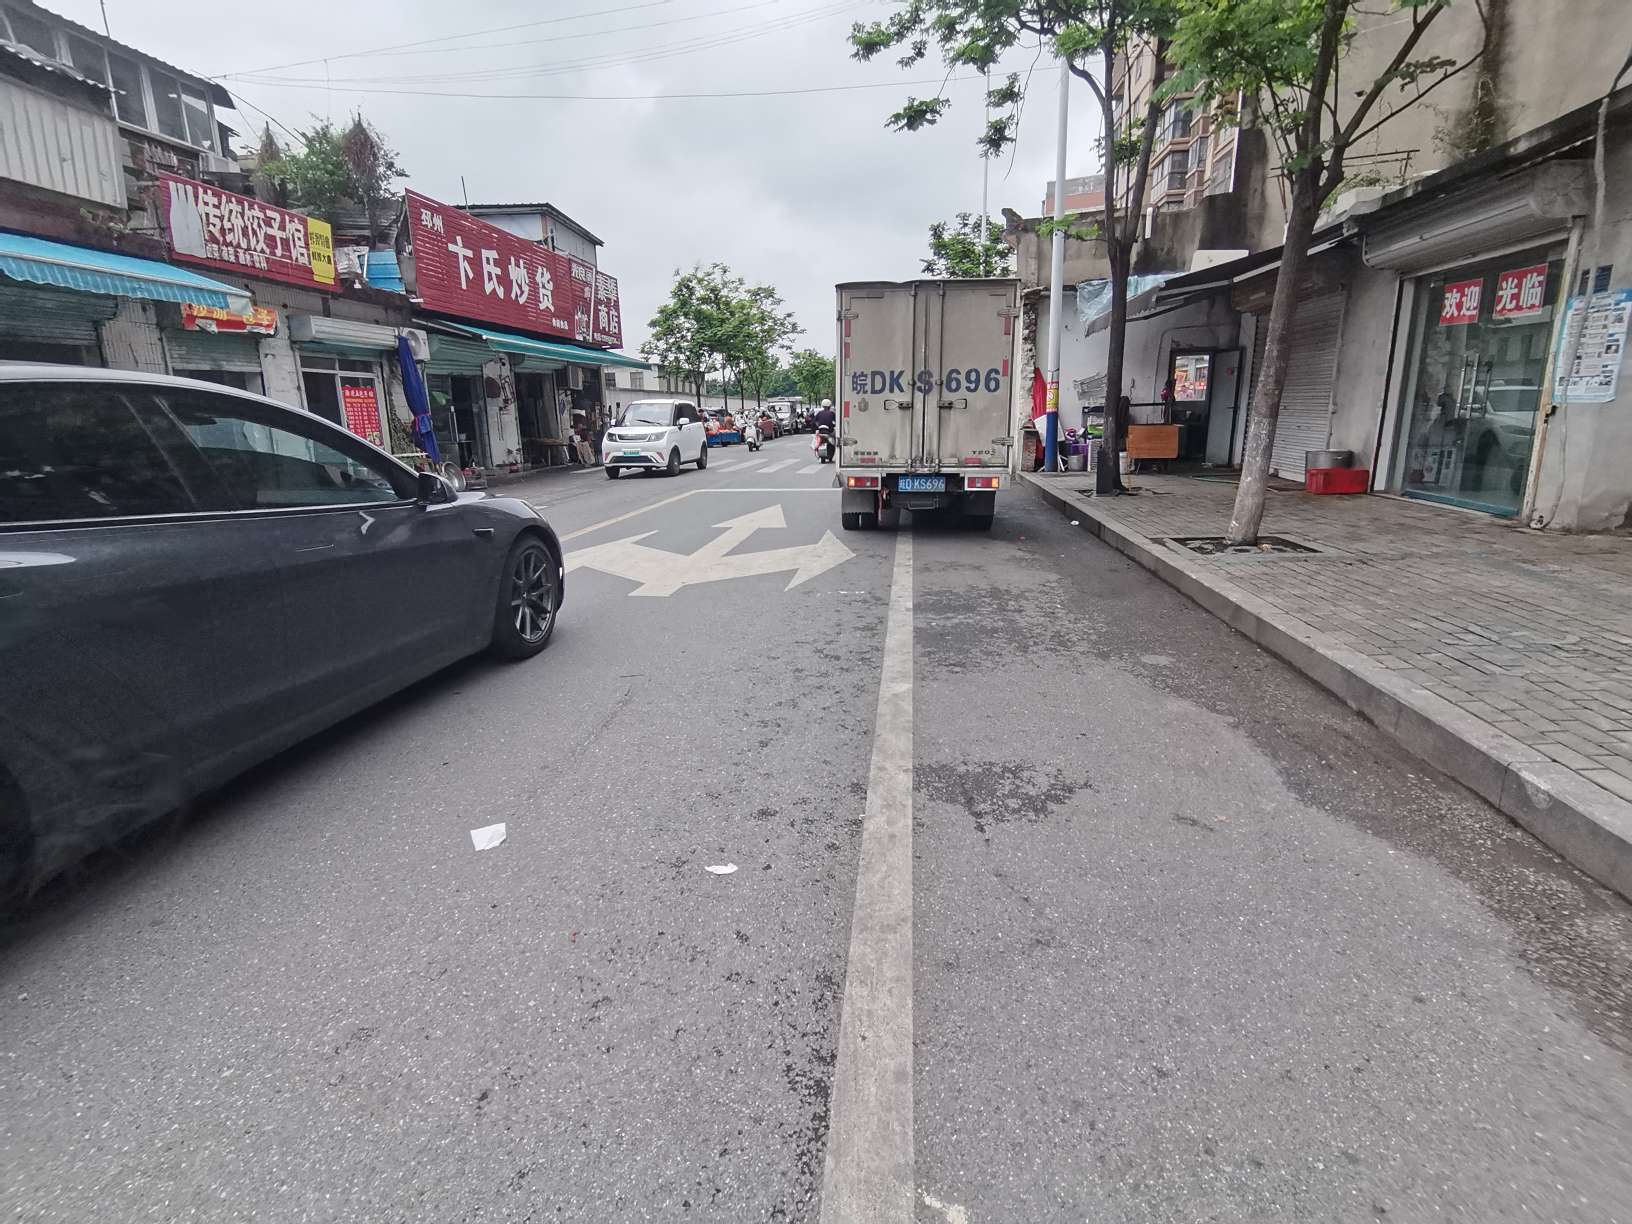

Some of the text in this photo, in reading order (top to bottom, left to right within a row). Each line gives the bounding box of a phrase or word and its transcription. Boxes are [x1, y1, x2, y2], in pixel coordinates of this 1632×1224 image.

[198, 186, 309, 265] 传统饺子馆
[447, 236, 554, 312] 卞氏炒货
[1496, 272, 1544, 311] 光临
[598, 304, 619, 335] 商店
[1442, 285, 1480, 318] 欢迎
